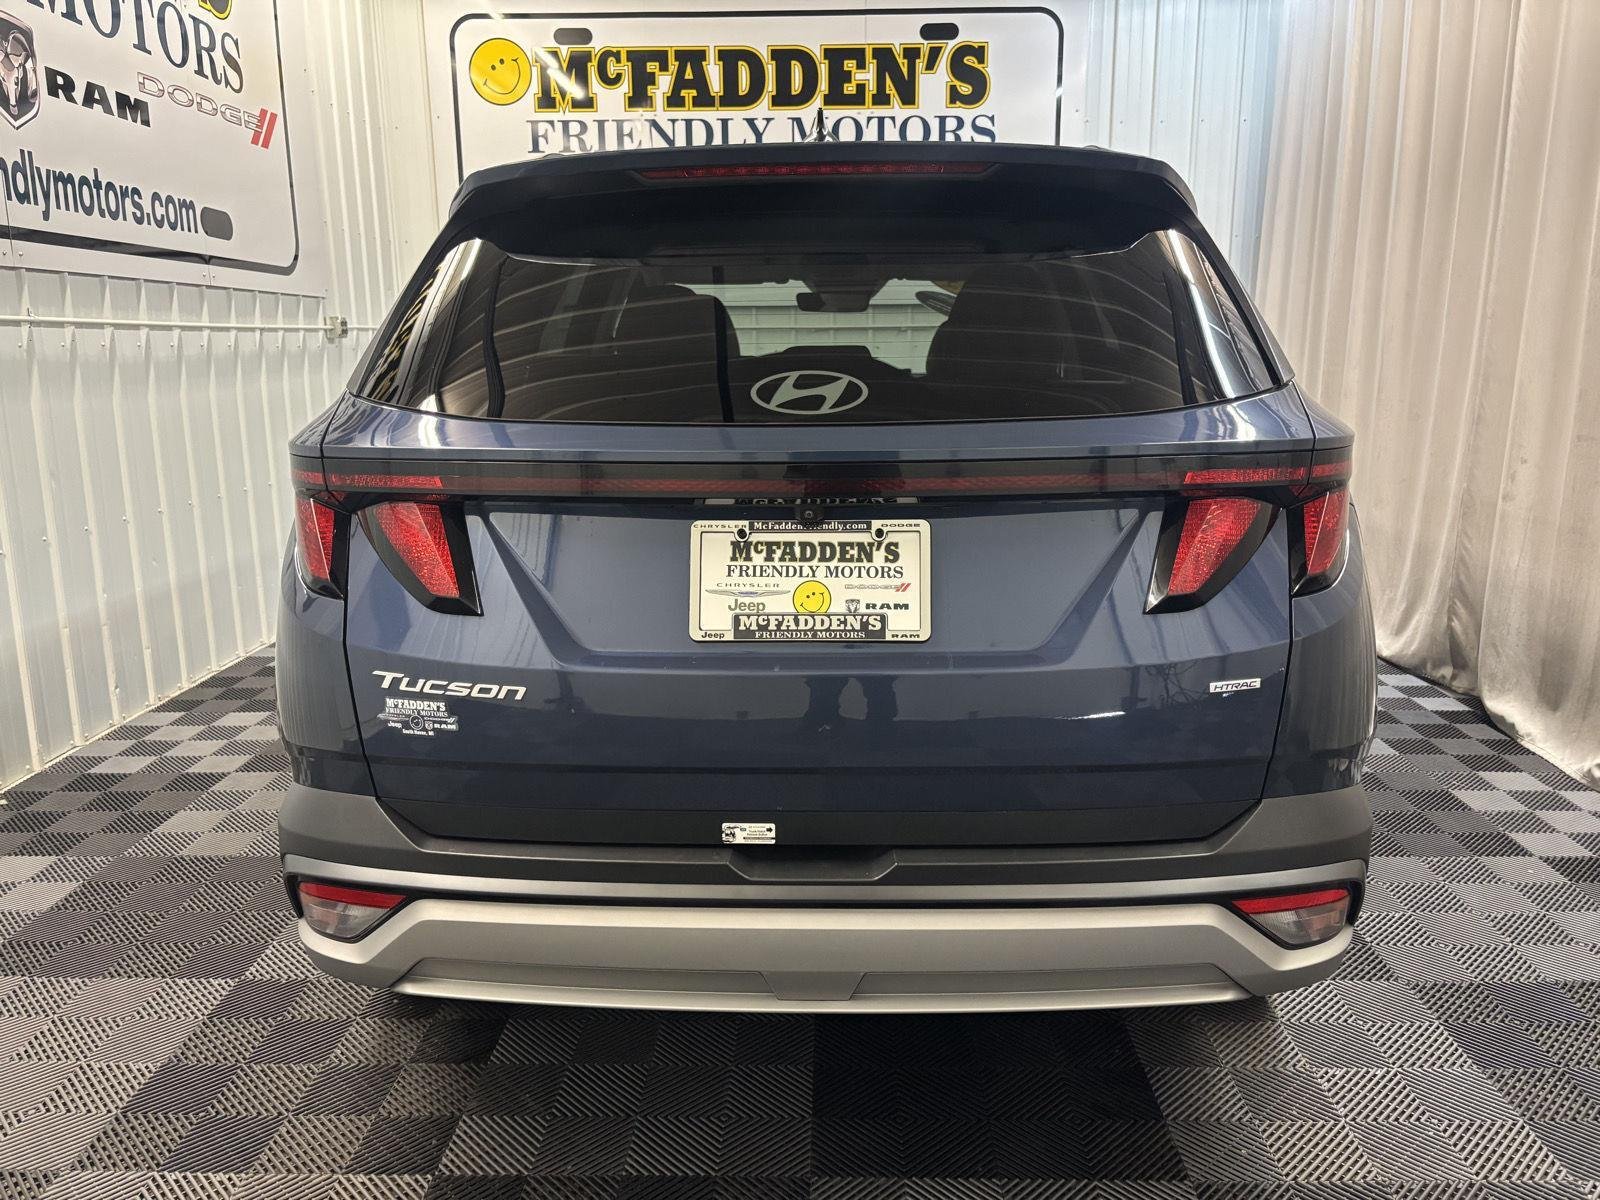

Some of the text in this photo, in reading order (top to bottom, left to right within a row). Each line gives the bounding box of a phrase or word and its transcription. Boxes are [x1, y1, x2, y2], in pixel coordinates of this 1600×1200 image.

[44, 66, 151, 128] RAM
[137, 72, 263, 133] DODGE
[526, 117, 774, 154] FRIENDLY
[726, 564, 904, 579] FRIENDLY MOTORS
[728, 598, 766, 613] Jeep
[865, 602, 910, 611] RAM
[701, 631, 725, 640] Jeep
[755, 631, 866, 639] FRIENDLY MOTORS
[1213, 681, 1258, 691] HTRAC
[385, 706, 418, 716] FRIENDLY
